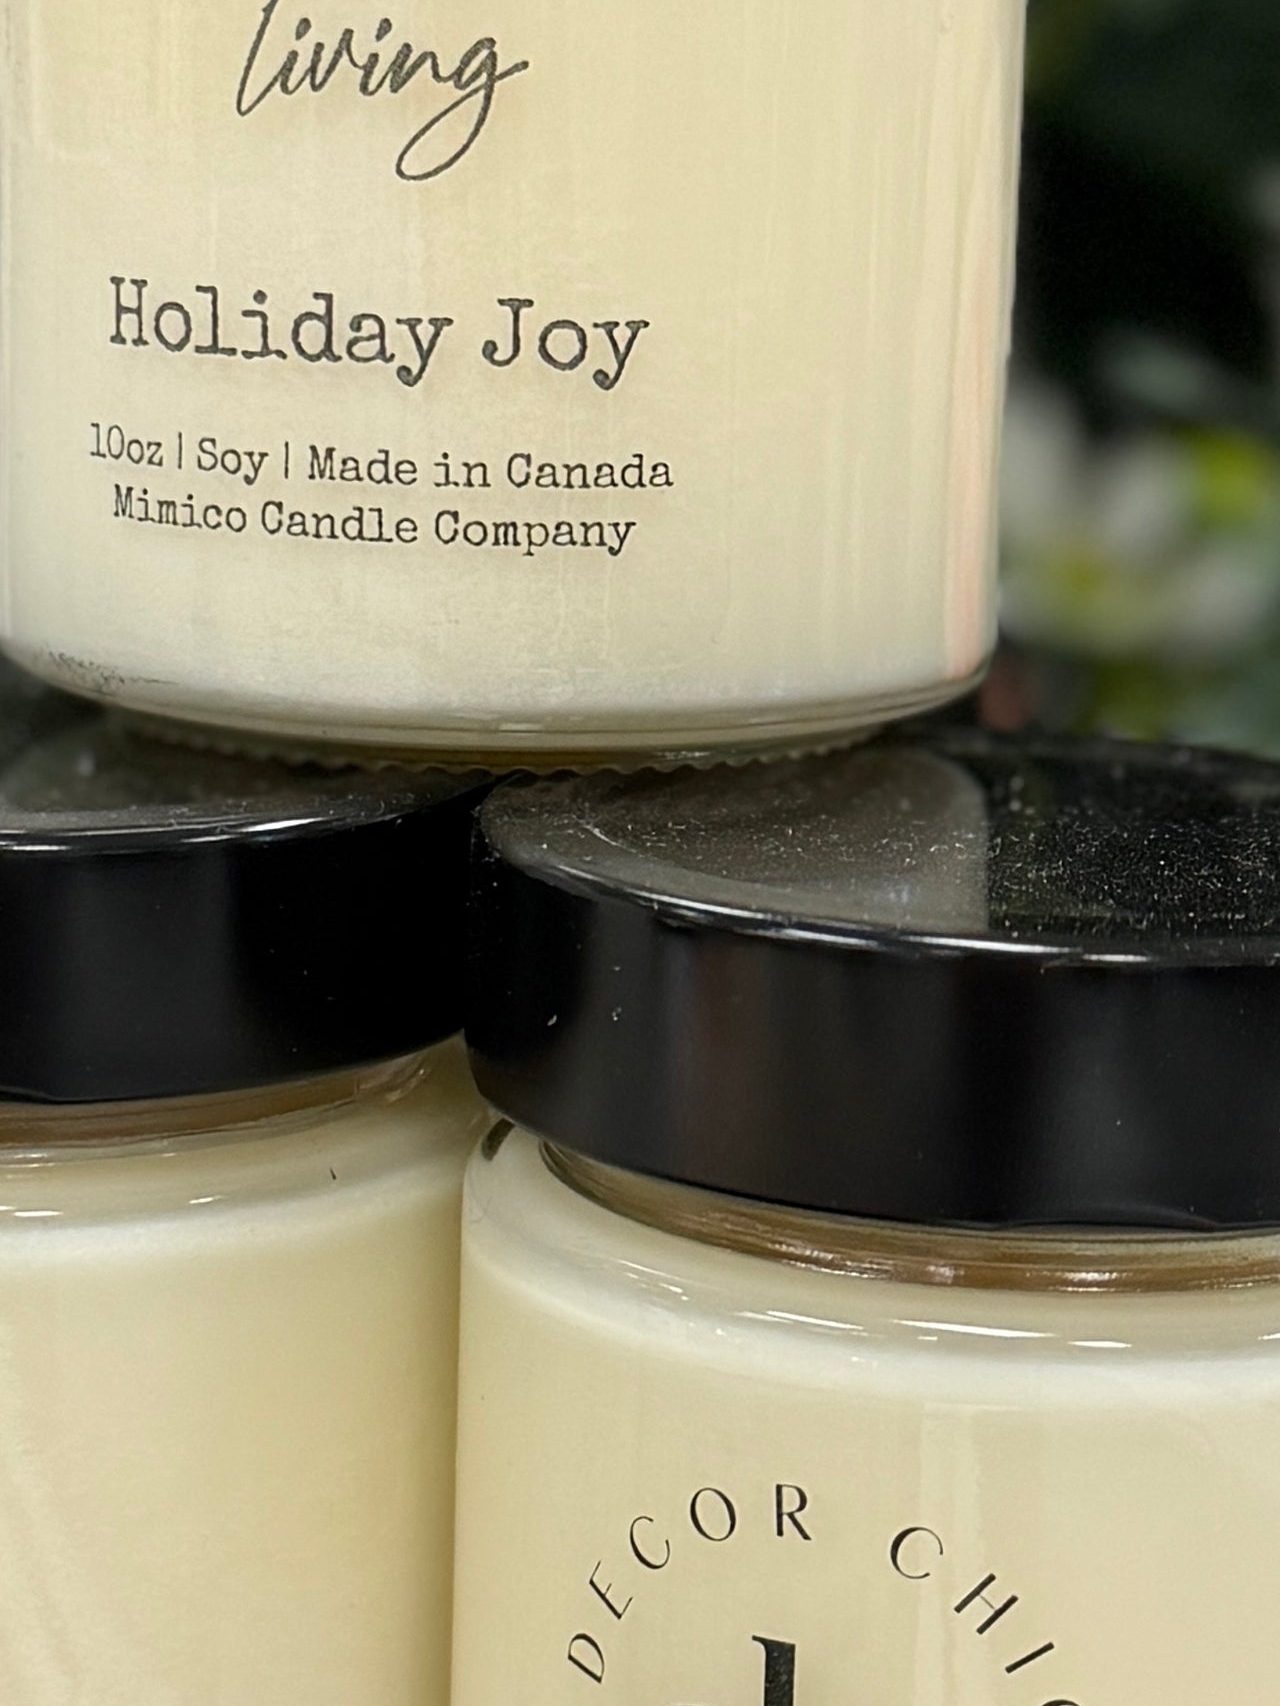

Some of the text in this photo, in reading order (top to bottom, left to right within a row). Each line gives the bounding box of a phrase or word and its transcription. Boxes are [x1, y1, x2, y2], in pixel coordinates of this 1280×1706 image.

[108, 275, 651, 392] Holiday Joy
[89, 422, 164, 468] 10oz
[196, 436, 270, 487] Soy
[307, 443, 418, 486] Made
[433, 451, 492, 489] in
[506, 452, 675, 490] Canada
[112, 482, 638, 558] Mimico Candle Company
[567, 1483, 813, 1685] DECOR
